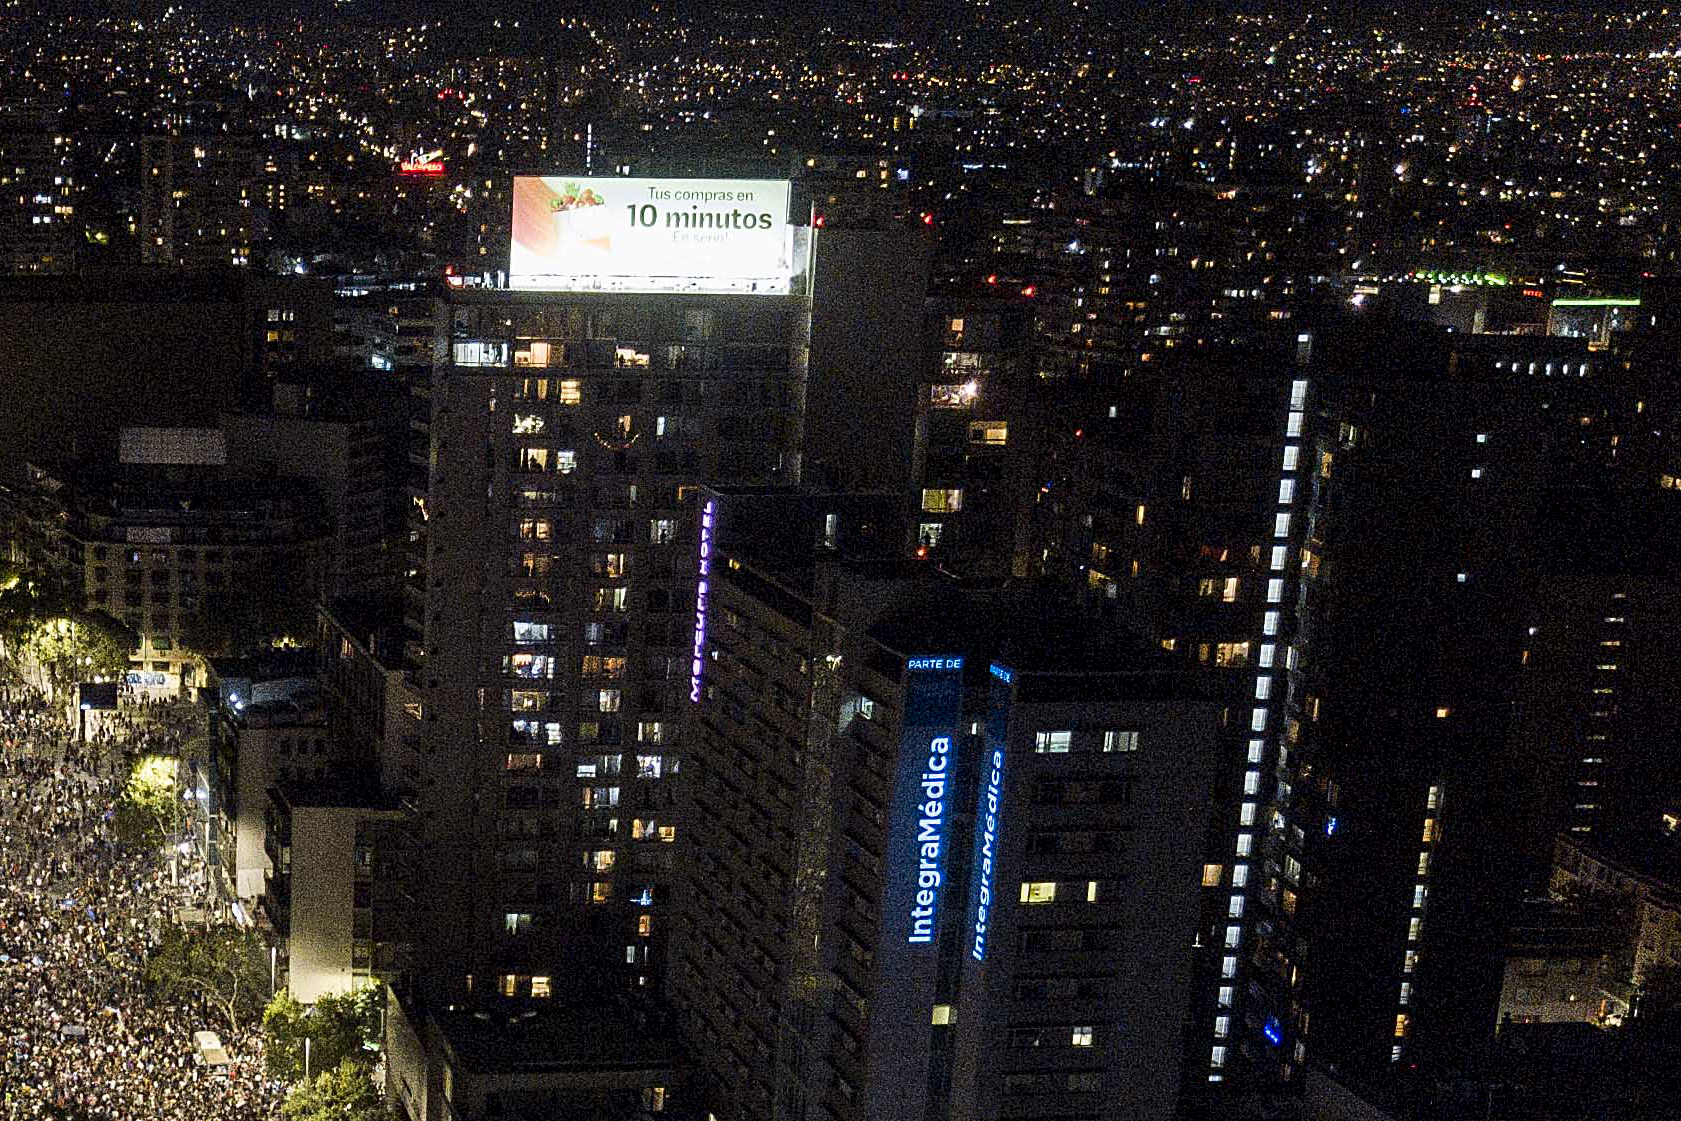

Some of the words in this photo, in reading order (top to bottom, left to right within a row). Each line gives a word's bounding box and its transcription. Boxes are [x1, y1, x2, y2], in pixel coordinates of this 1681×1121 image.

[627, 204, 657, 227] 10
[666, 205, 773, 229] minutos
[648, 187, 671, 200] Tus
[675, 191, 734, 204] compras
[737, 191, 754, 201] en
[700, 501, 712, 575] HOTEL
[908, 659, 943, 669] PARTE
[946, 659, 961, 669] DE
[908, 737, 949, 943] IntegraMédica
[973, 751, 1002, 961] IntegraMédica
